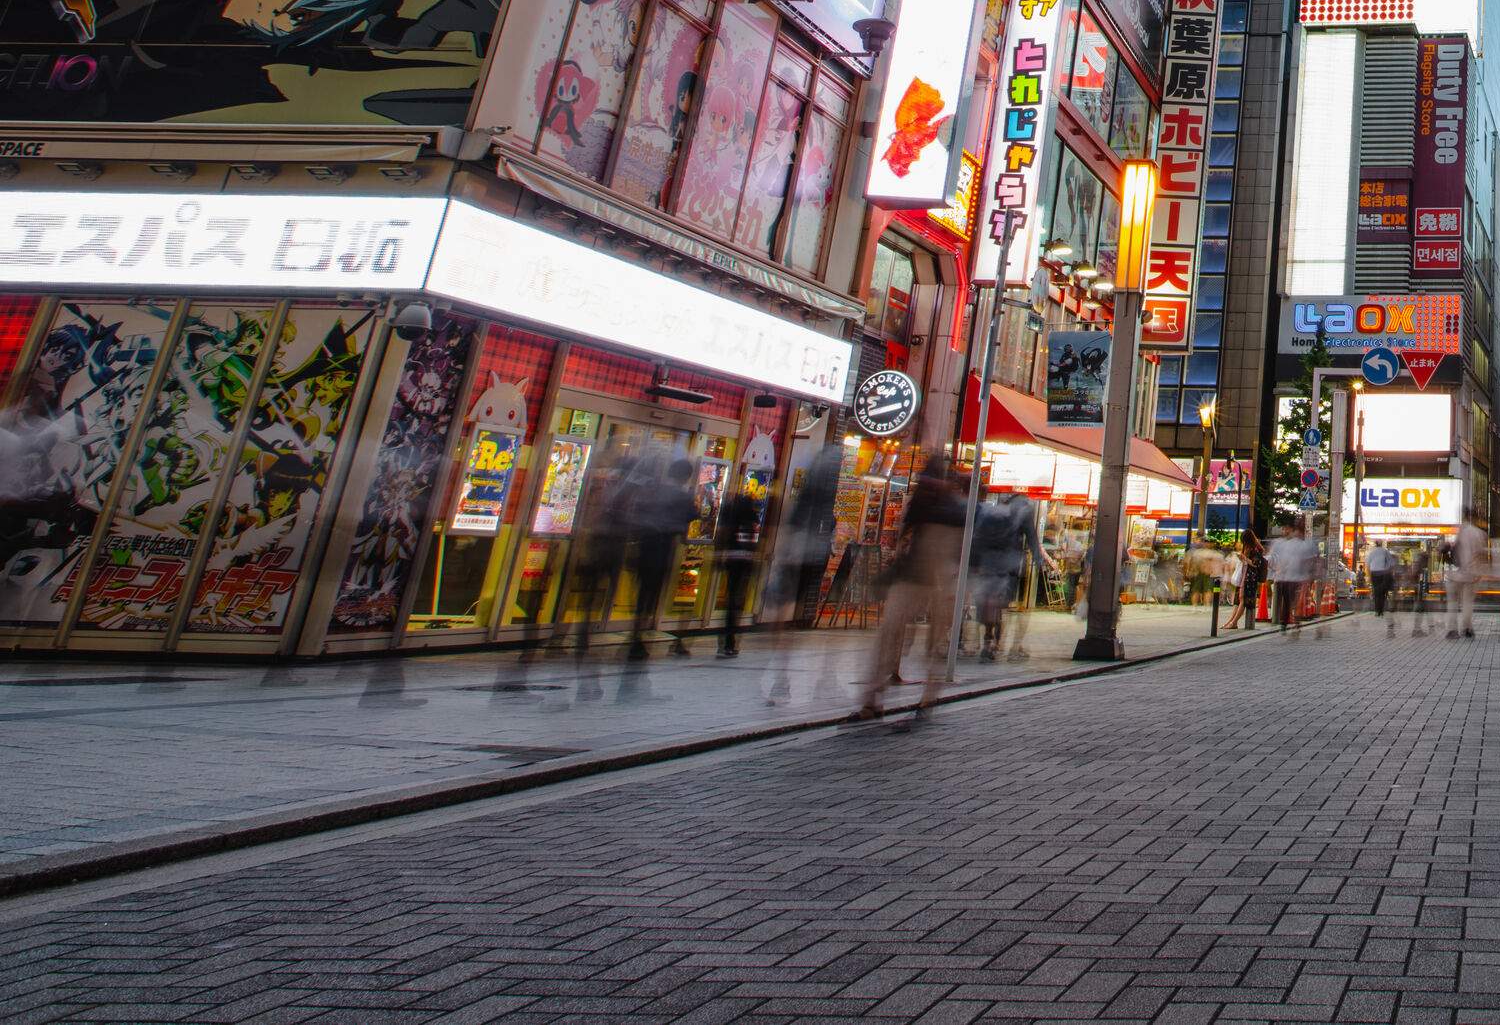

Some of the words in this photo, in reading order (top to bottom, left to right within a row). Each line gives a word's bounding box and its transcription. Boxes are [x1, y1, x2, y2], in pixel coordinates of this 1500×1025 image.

[1418, 43, 1436, 97] Flagship
[1434, 43, 1465, 103] Duty
[1420, 100, 1431, 136] Store
[1434, 105, 1459, 165] Free
[1419, 213, 1458, 232] 免税
[1417, 247, 1458, 263] 면세점
[1409, 357, 1437, 369] 止まれ
[861, 371, 911, 394] SMOKER'S
